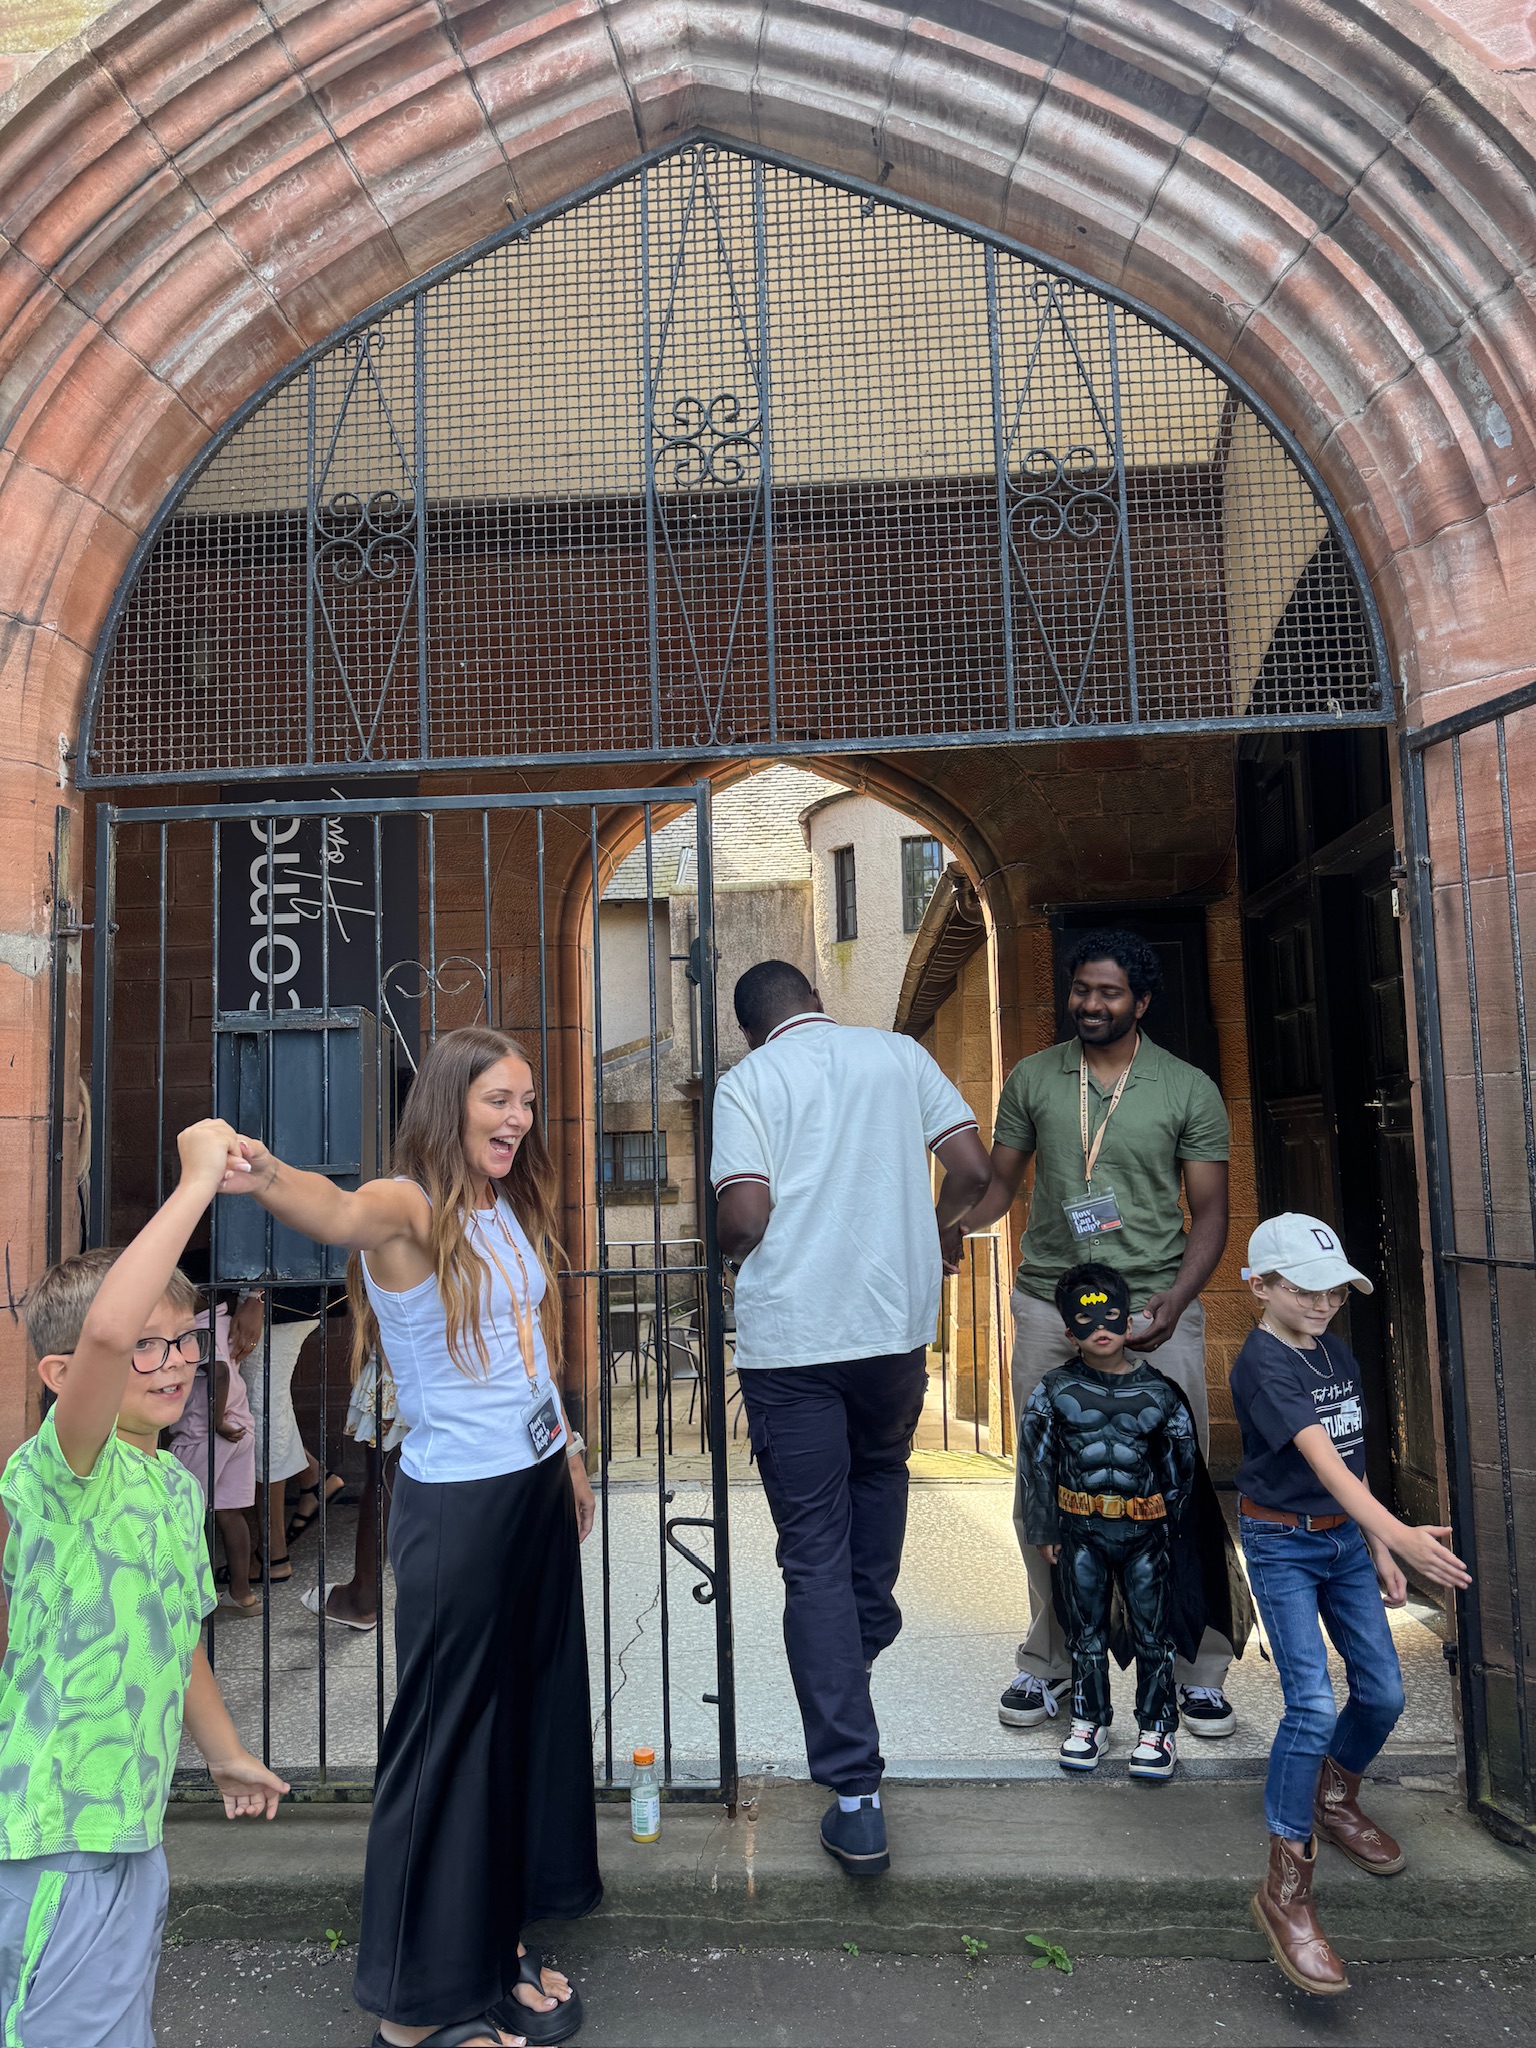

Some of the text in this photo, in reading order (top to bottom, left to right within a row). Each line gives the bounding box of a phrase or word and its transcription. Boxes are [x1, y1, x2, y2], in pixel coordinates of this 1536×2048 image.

[284, 787, 384, 943] Hom
[1071, 1209, 1092, 1221] How
[1074, 1216, 1092, 1227] Can
[1091, 1214, 1096, 1223] I
[1076, 1220, 1101, 1234] Help?
[1310, 1229, 1334, 1250] D
